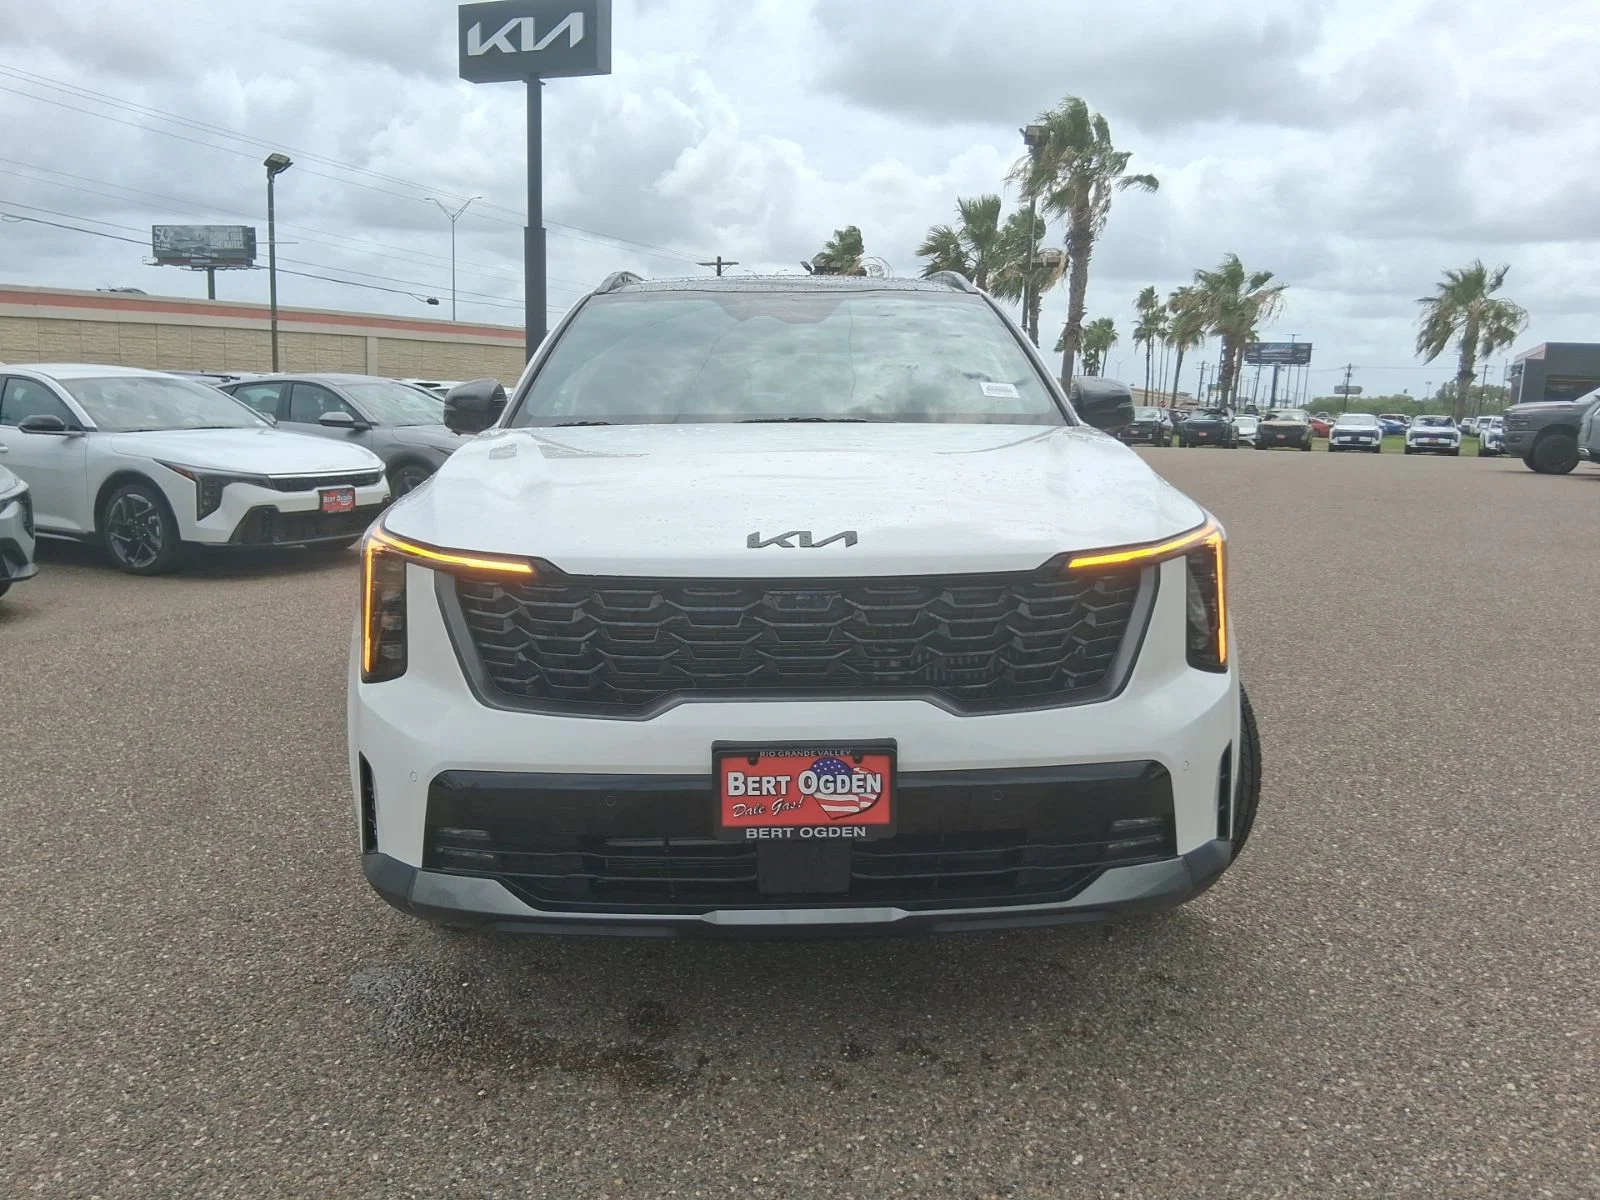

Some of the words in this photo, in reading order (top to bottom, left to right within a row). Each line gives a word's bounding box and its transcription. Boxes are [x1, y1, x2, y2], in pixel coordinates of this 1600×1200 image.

[467, 12, 584, 56] KIA
[747, 530, 858, 548] KIA
[727, 771, 791, 796] BERT
[798, 770, 882, 795] OGDEN
[732, 803, 765, 818] Dale
[771, 795, 804, 816] Gas!
[745, 827, 794, 839] BERT
[799, 826, 866, 838] OGDEN
